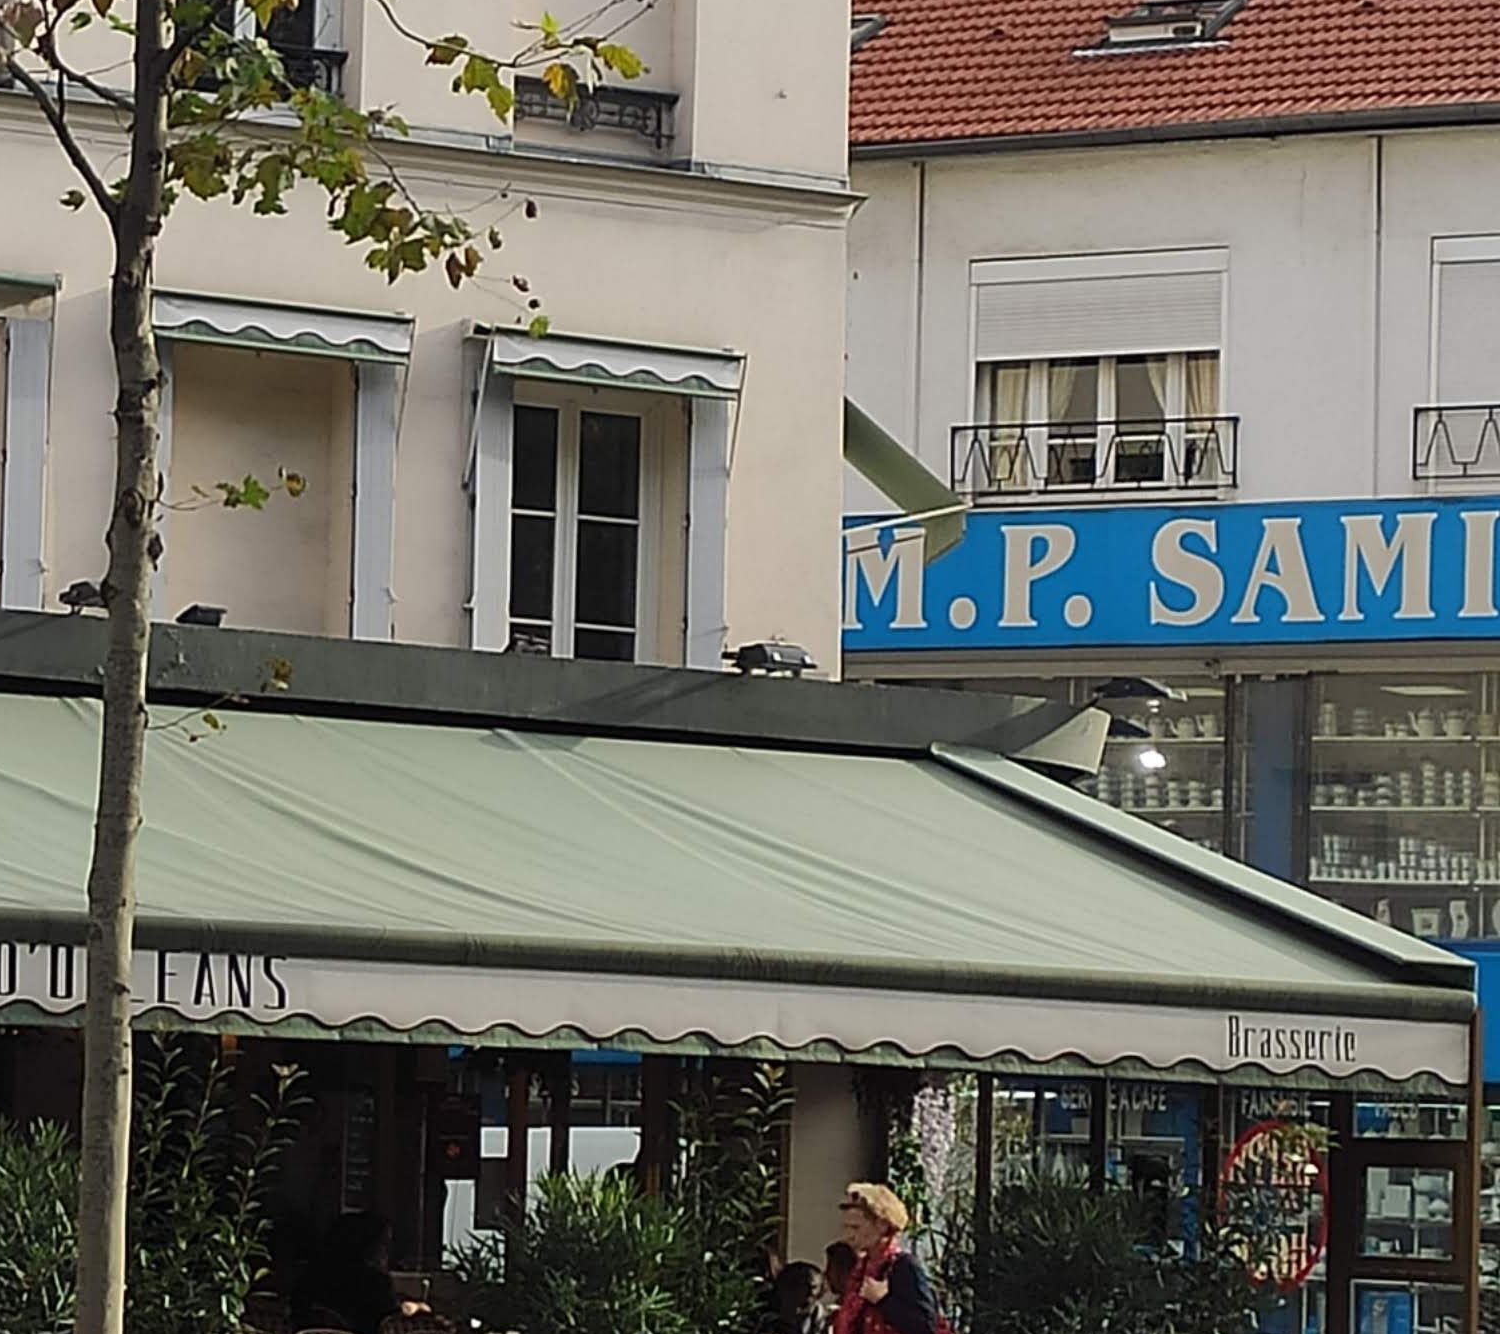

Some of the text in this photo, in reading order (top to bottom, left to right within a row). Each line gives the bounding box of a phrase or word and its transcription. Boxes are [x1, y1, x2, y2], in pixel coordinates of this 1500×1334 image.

[843, 509, 1500, 630] M.P. SAMI
[1227, 1015, 1357, 1063] Brasserie
